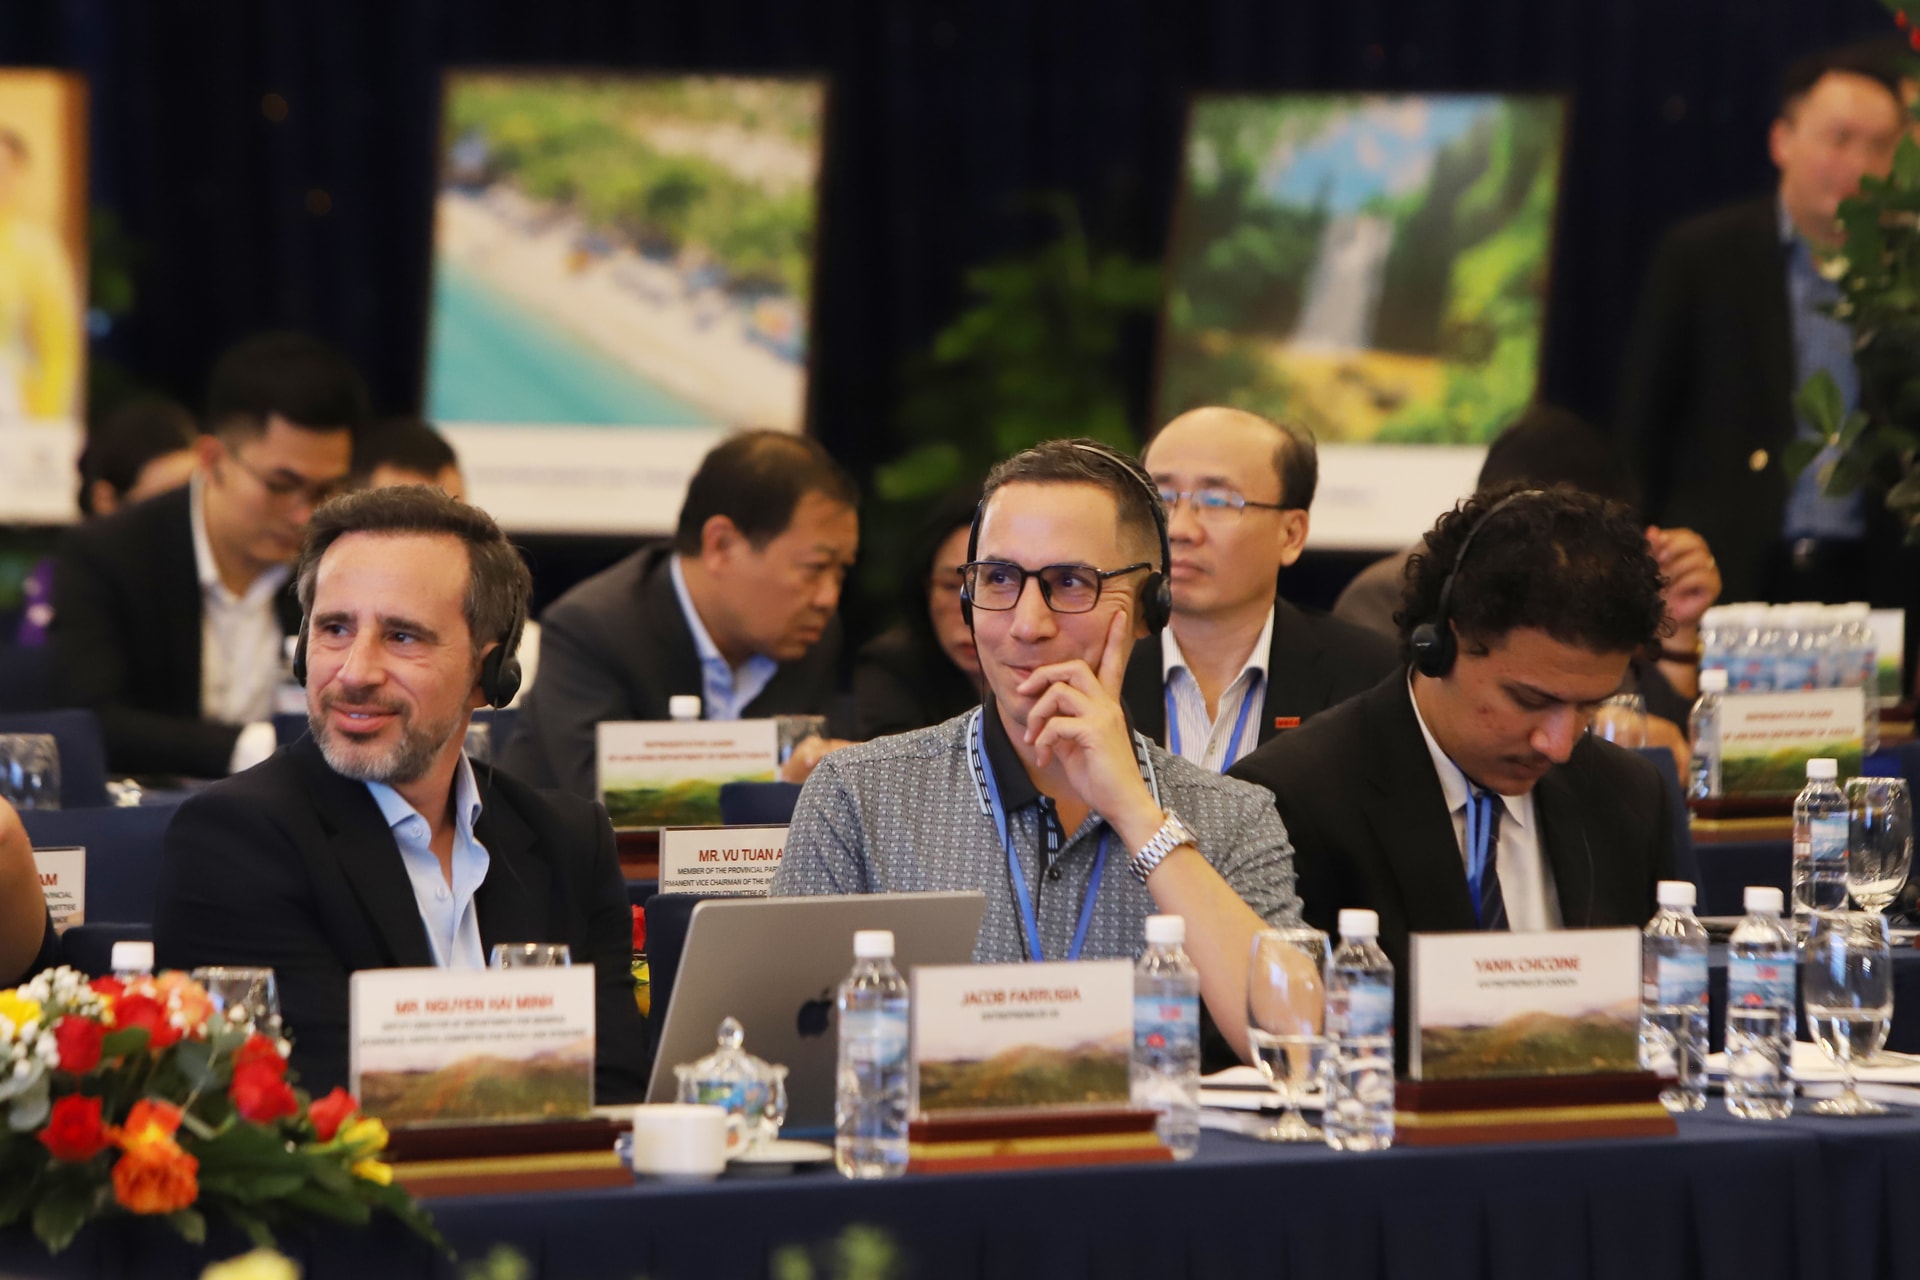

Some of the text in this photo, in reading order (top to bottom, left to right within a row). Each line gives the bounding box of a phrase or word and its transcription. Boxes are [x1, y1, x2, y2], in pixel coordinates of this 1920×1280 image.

[699, 850, 720, 862] MR.
[722, 849, 739, 861] VU
[742, 848, 774, 861] TUAN
[728, 866, 763, 874] PROVINCIAL
[710, 878, 741, 886] CHAIRMAN
[753, 877, 764, 885] THE
